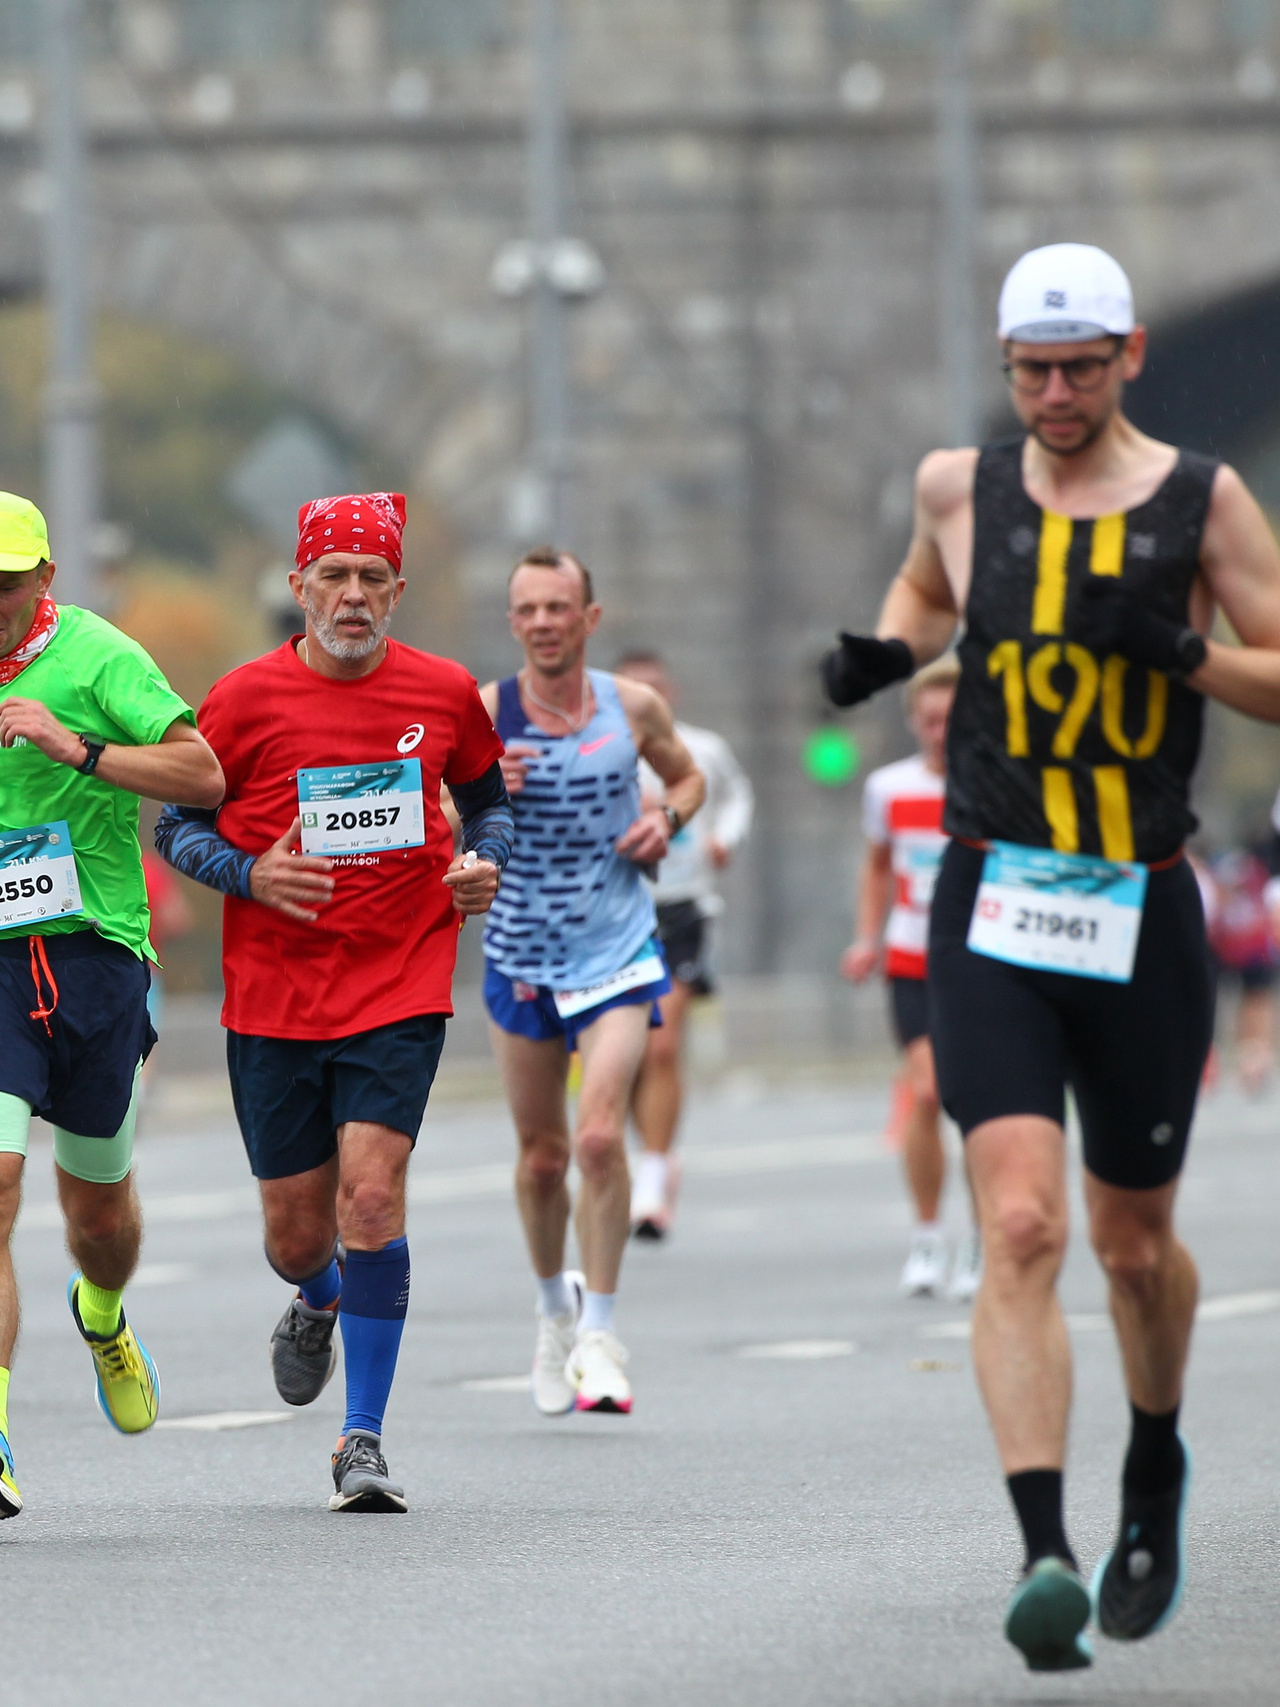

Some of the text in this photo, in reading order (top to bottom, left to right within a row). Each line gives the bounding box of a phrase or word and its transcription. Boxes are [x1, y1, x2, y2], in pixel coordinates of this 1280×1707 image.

[987, 640, 1167, 760] 190
[325, 806, 401, 831] 20857
[331, 857, 380, 867] МАРАФОН
[1014, 906, 1099, 944] 21961
